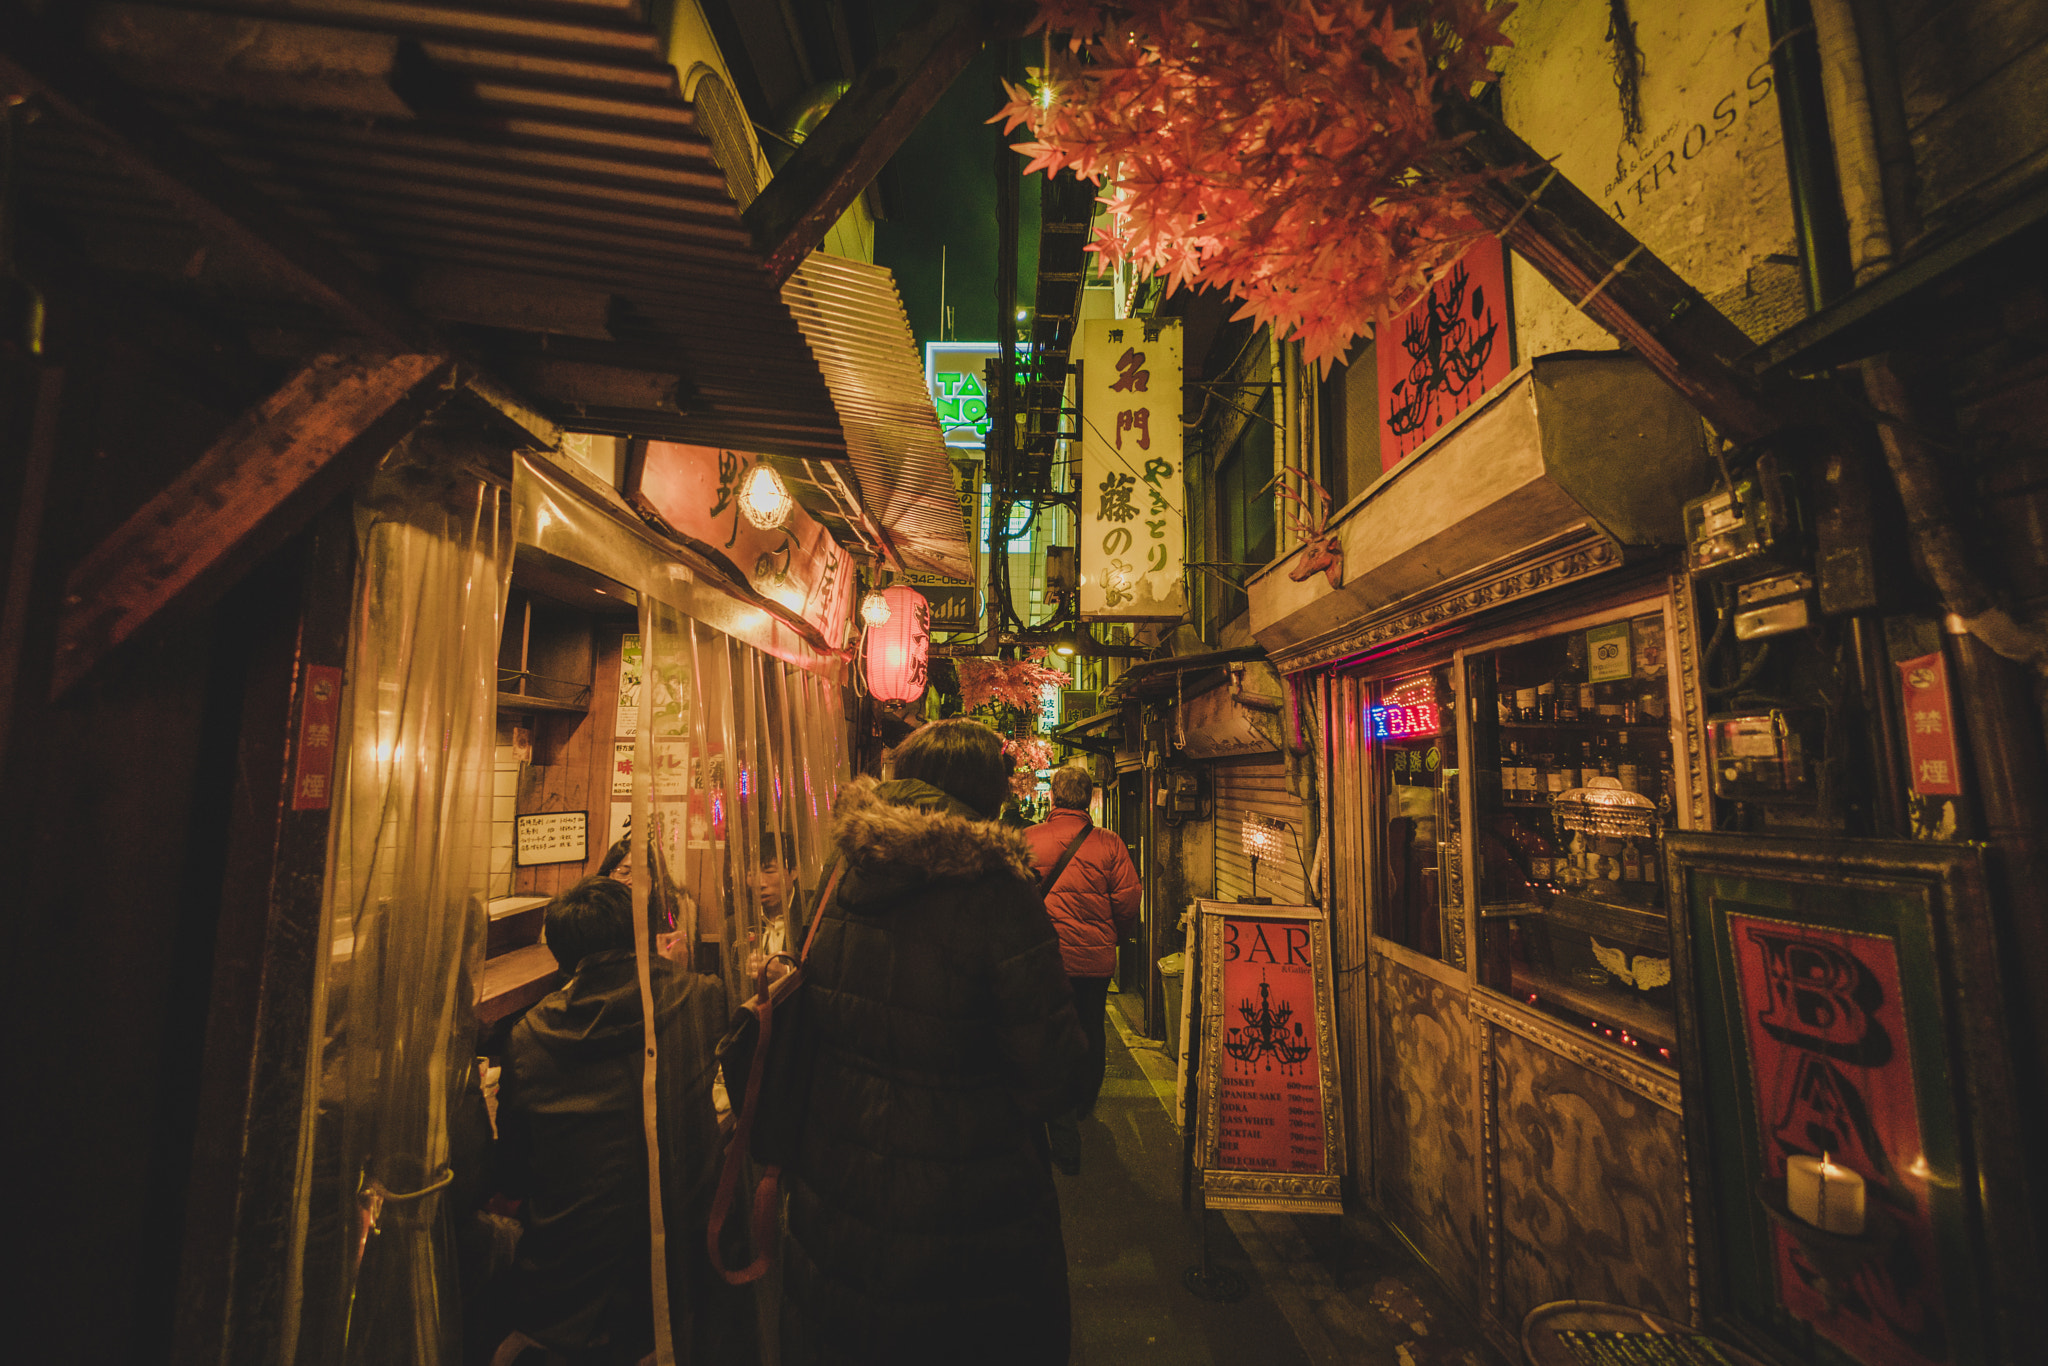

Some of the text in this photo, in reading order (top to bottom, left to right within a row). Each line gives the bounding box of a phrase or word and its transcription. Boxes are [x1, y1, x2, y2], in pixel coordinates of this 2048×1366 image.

[1608, 60, 1774, 222] ATROSS
[1108, 347, 1151, 451] 名門
[1143, 457, 1175, 573] やきとり
[928, 596, 966, 620] sahi
[1042, 698, 1055, 731] 岐阜屋
[1388, 705, 1436, 734] BAR
[301, 723, 331, 798] 禁煙
[1914, 709, 1950, 785] 禁煙
[1224, 923, 1312, 967] BAR
[1221, 1090, 1282, 1101] APANESE SAKE
[1221, 1103, 1248, 1112] ODKA
[1221, 1128, 1262, 1139] OCKTAIL
[1222, 1116, 1275, 1126] LASS WHITE
